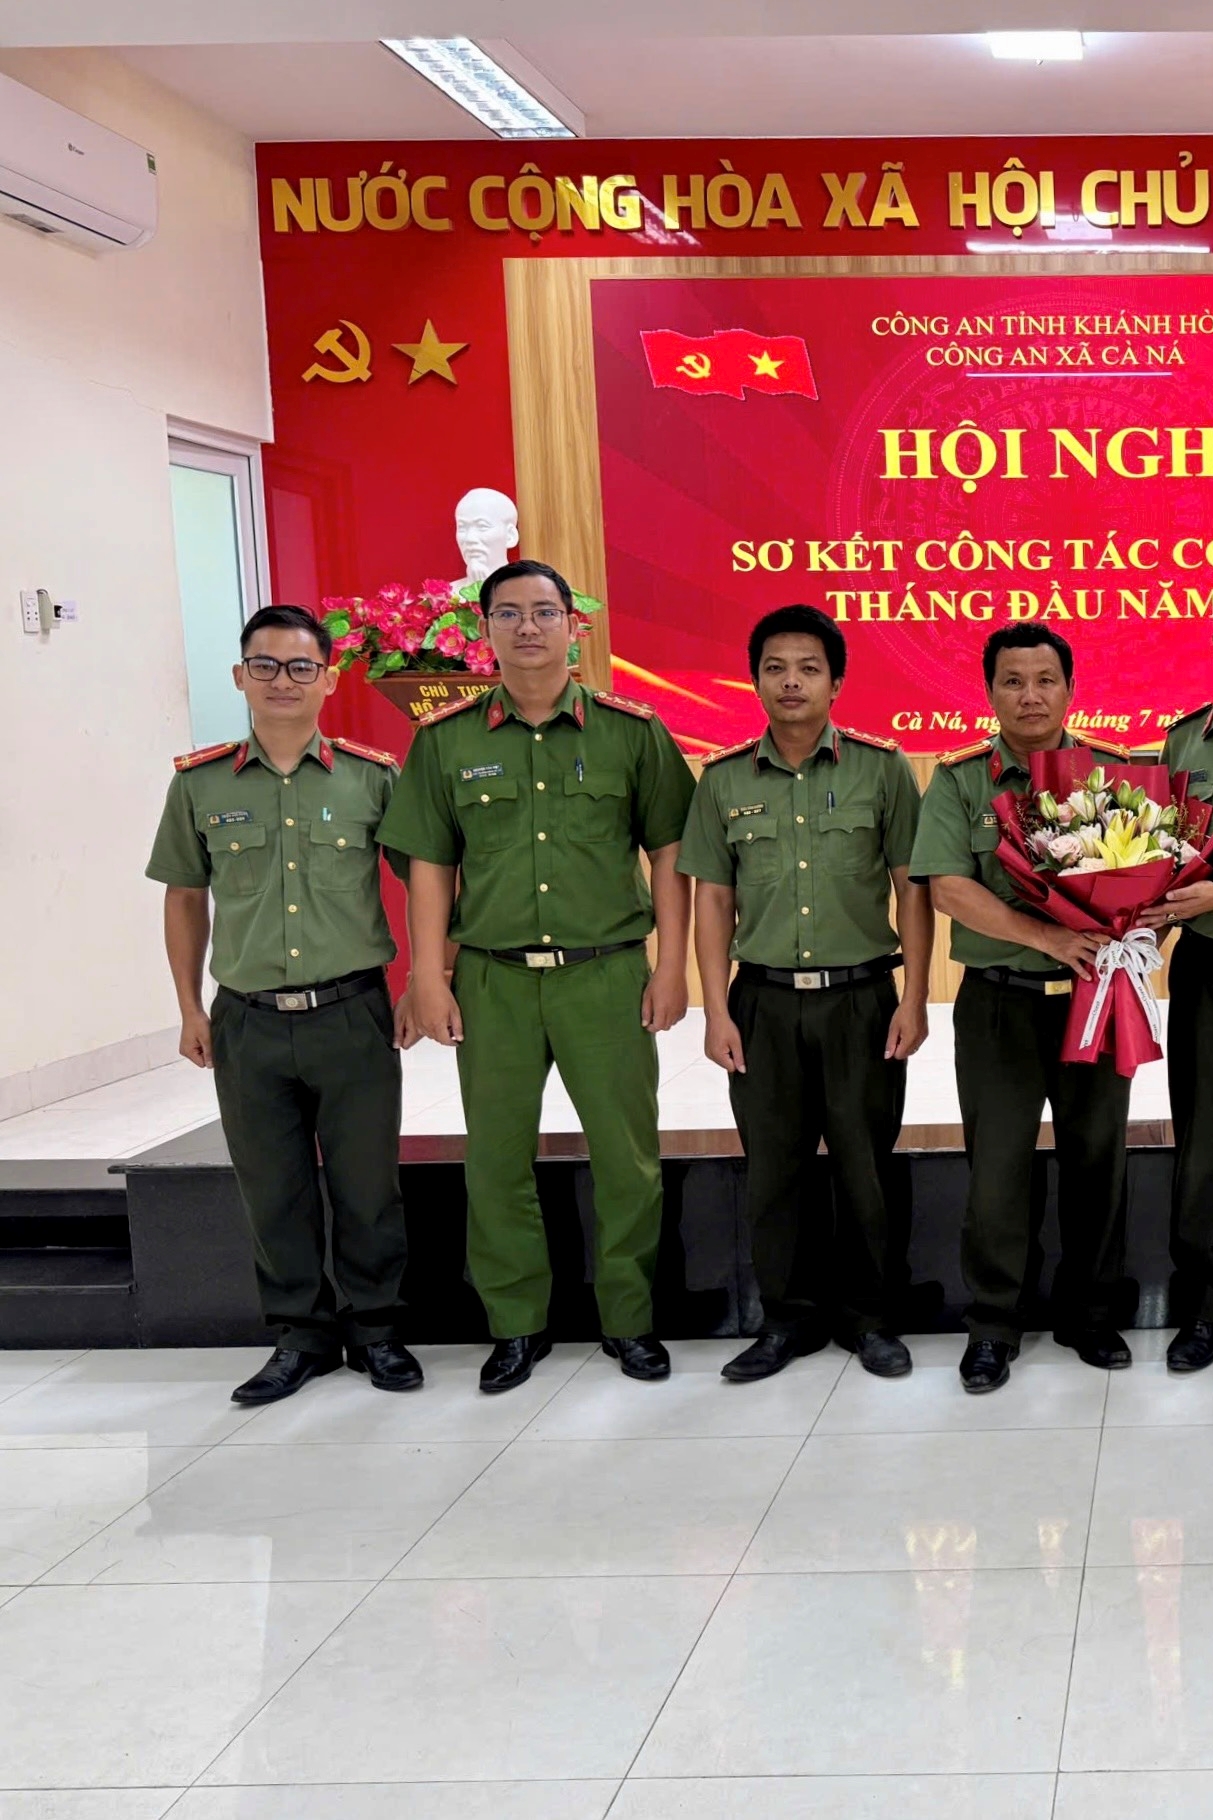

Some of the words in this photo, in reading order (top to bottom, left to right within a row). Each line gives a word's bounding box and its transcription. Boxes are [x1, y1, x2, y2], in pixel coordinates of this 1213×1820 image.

[271, 161, 451, 232] NƯỚC
[469, 162, 642, 241] CỘNG
[663, 159, 801, 229] HÒA
[821, 161, 919, 228] XÃ
[948, 157, 1055, 237] HỘI
[1081, 151, 1209, 226] CHỦ
[871, 311, 948, 336] CÔNG
[956, 317, 993, 335] AN
[1001, 311, 1067, 335] TỈNH
[1074, 310, 1171, 335] KHÁNH
[926, 341, 1003, 366] CÔNG
[1010, 347, 1047, 365] AN
[1055, 342, 1094, 366] XÃ
[1101, 341, 1138, 365] CÀ
[1148, 341, 1185, 365] NÁ
[877, 420, 1028, 493] HỘI
[731, 538, 795, 572] SƠ
[805, 531, 903, 571] KẾT
[915, 530, 1053, 571] CÔNG
[1064, 530, 1159, 570] TÁC
[826, 582, 993, 621] THÁNG
[1007, 580, 1106, 620] ĐẦU
[419, 681, 449, 697] CHỦ
[891, 711, 922, 731] Cà
[928, 711, 968, 733] Ná,
[974, 716, 1001, 735] ng
[1067, 709, 1131, 733] tháng
[1139, 709, 1152, 728] 7
